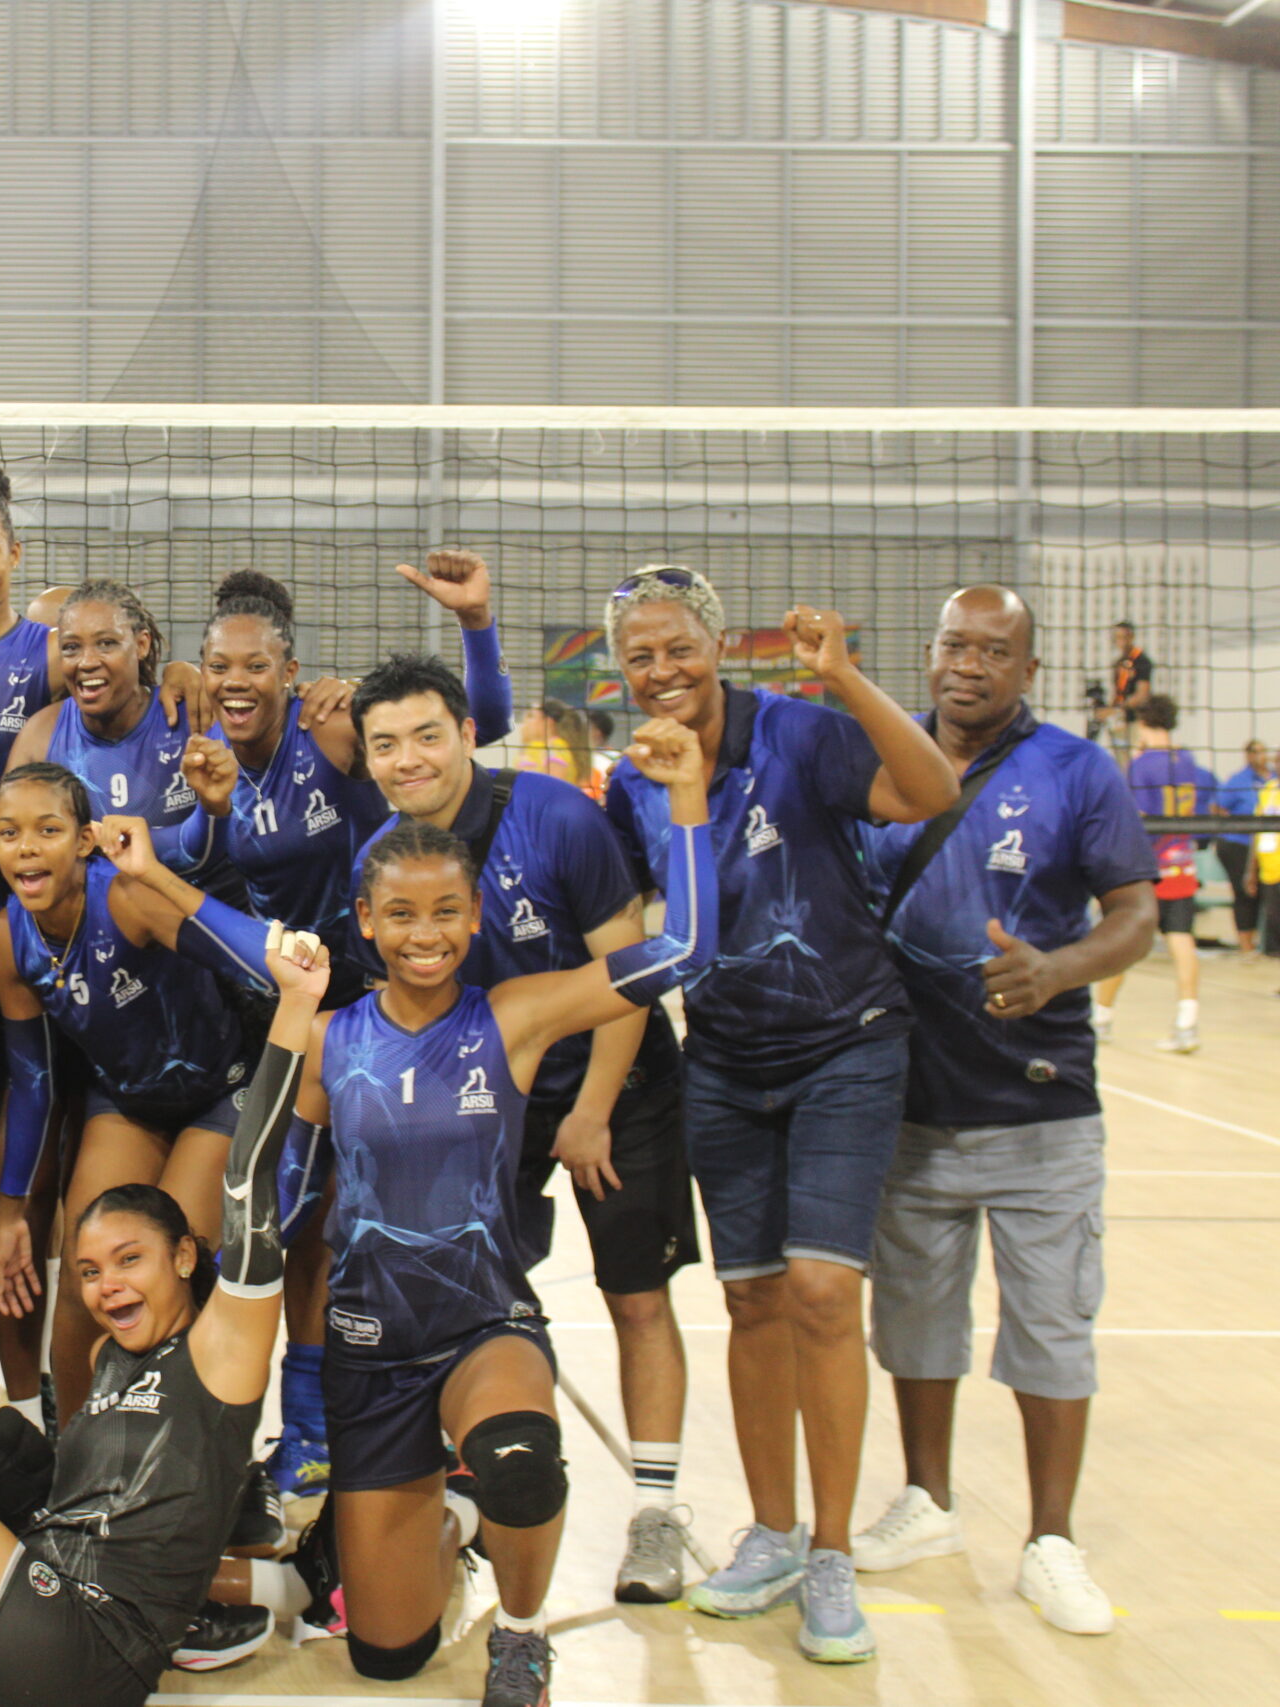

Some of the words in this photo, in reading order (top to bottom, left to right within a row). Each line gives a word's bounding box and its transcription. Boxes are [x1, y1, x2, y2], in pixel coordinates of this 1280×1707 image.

[111, 773, 128, 807] 9
[167, 790, 195, 808] ARSU
[253, 798, 278, 835] 11
[307, 808, 338, 831] ARSU
[70, 973, 89, 1005] 5
[115, 979, 143, 1004] ARSU
[399, 1067, 415, 1104] 1
[460, 1094, 494, 1109] ARSU
[121, 1393, 161, 1408] ARSU
